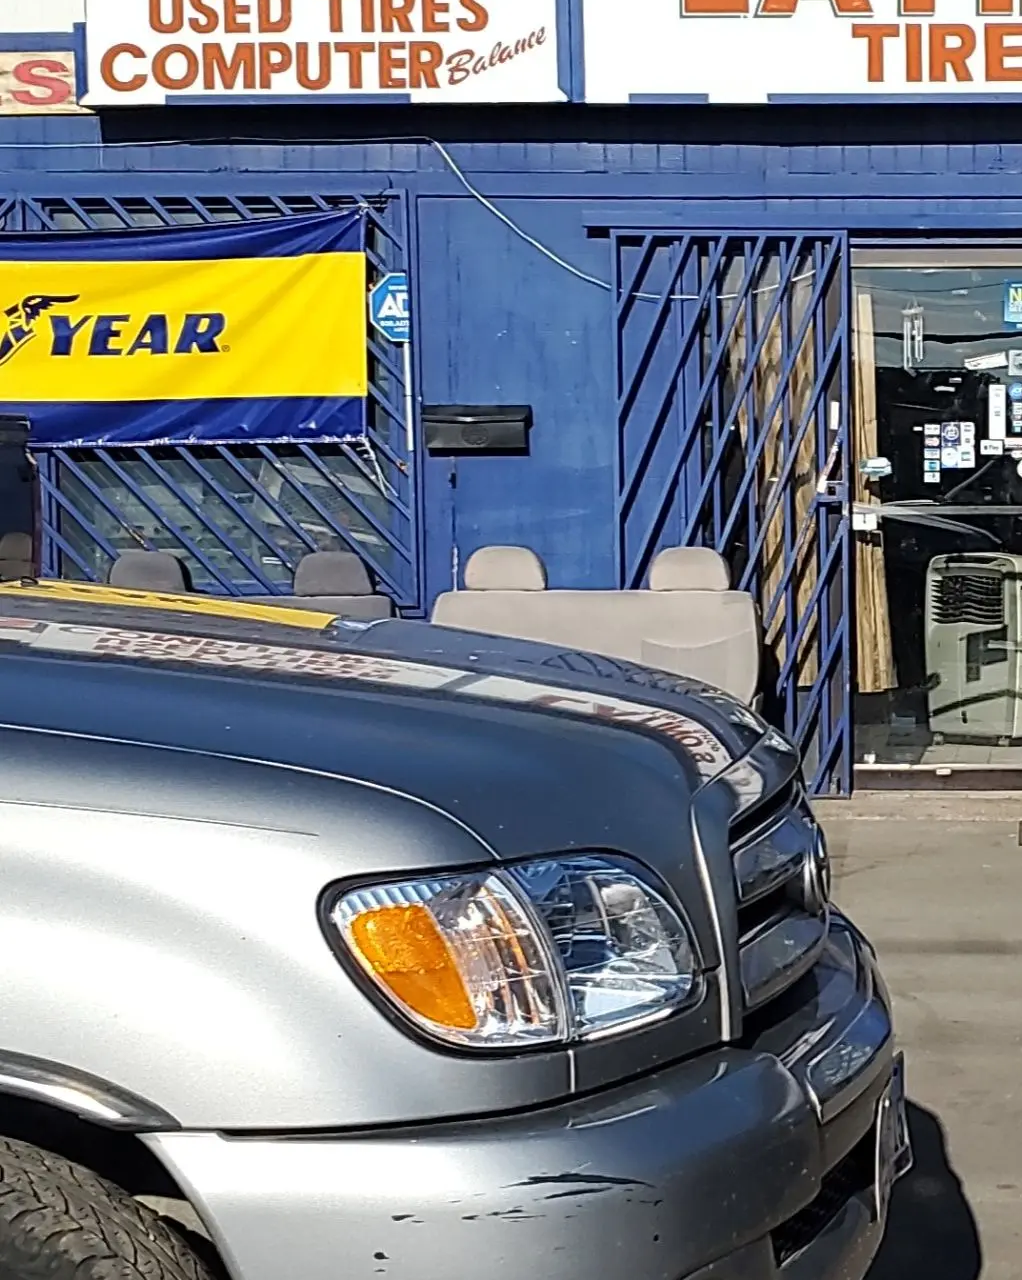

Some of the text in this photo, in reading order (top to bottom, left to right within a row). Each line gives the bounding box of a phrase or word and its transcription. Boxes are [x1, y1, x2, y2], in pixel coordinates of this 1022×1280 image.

[100, 26, 547, 91] COMPUTER Balance
[377, 292, 410, 318] AD
